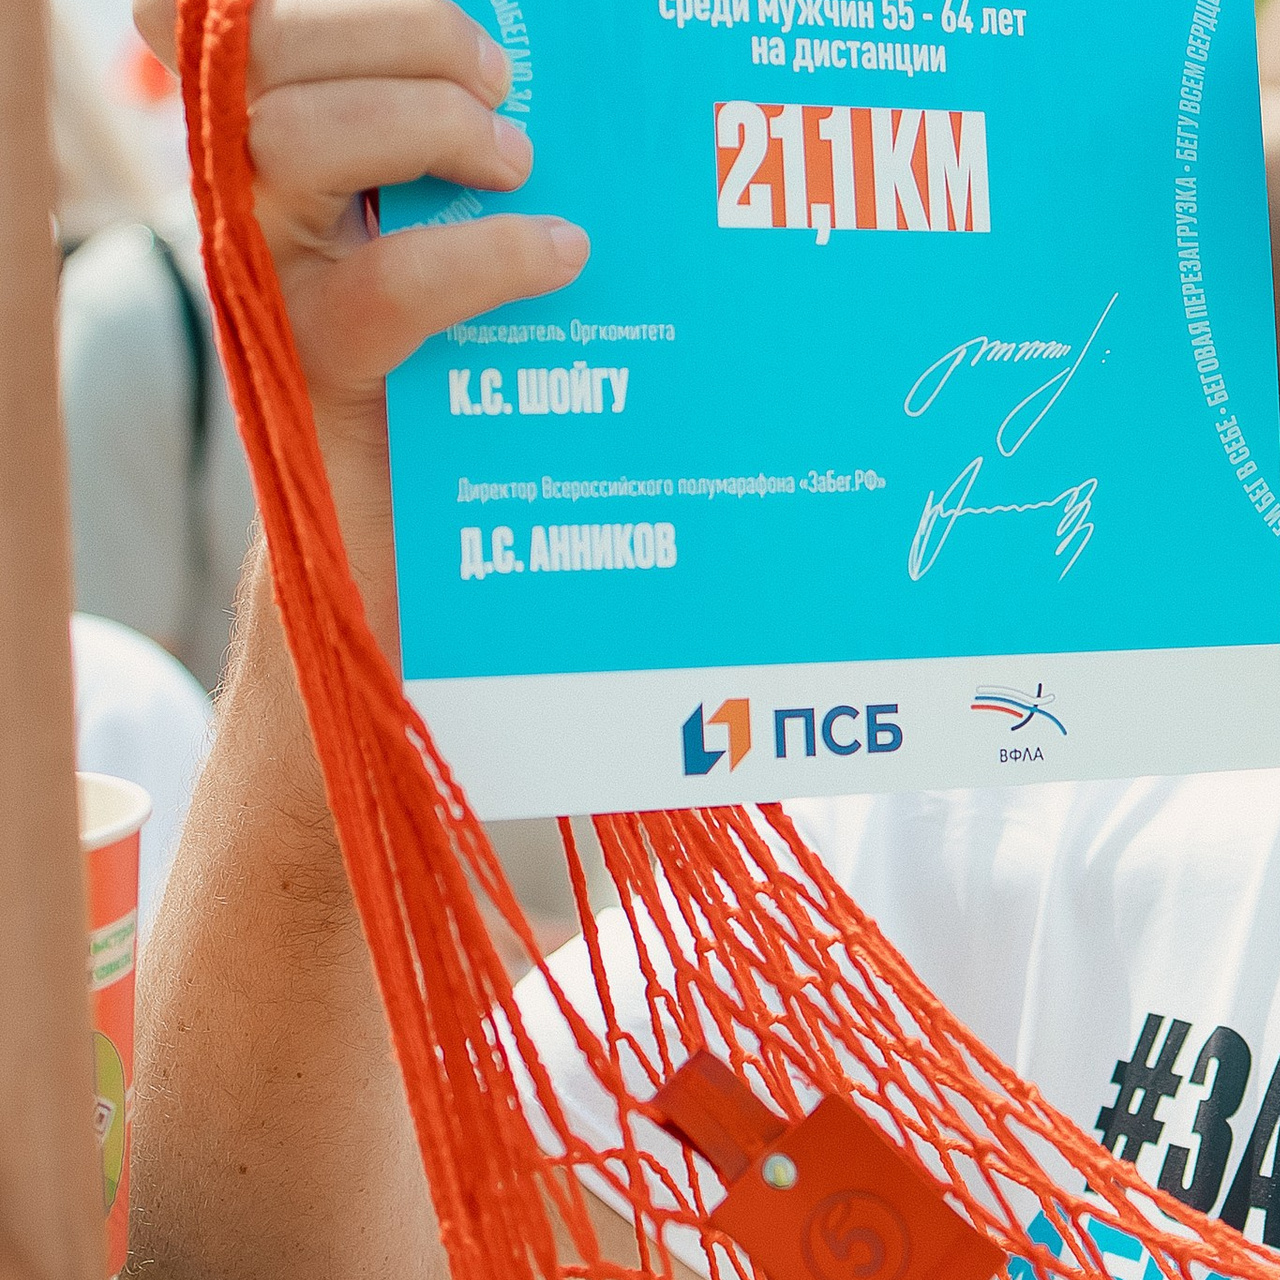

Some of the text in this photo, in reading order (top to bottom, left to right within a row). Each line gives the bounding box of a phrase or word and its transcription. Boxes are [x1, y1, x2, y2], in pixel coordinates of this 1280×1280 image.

[980, 5, 1027, 37] лет
[751, 36, 947, 77] на дистанции
[1179, 60, 1206, 114] ВСЕМ
[1175, 114, 1200, 162] БЕГУ
[716, 100, 991, 246] 21,1 КМ
[1174, 177, 1230, 407] БЕГОВАЯ ПЕРЕЗАГРУЗКА
[447, 318, 676, 347] Председатель Оргкомитета
[448, 360, 630, 415] К.С. ШОЙГУ
[1215, 414, 1251, 466] СЕБЕ
[457, 476, 538, 504] Директор
[542, 475, 674, 502] Всероссийского
[678, 472, 796, 500] полумарафона
[1235, 459, 1258, 482] В
[1243, 476, 1280, 512] БЕГ
[460, 521, 678, 581] Д.С. АННИКОВ
[774, 703, 904, 759] ПСБ
[999, 746, 1045, 764] ВФЛА
